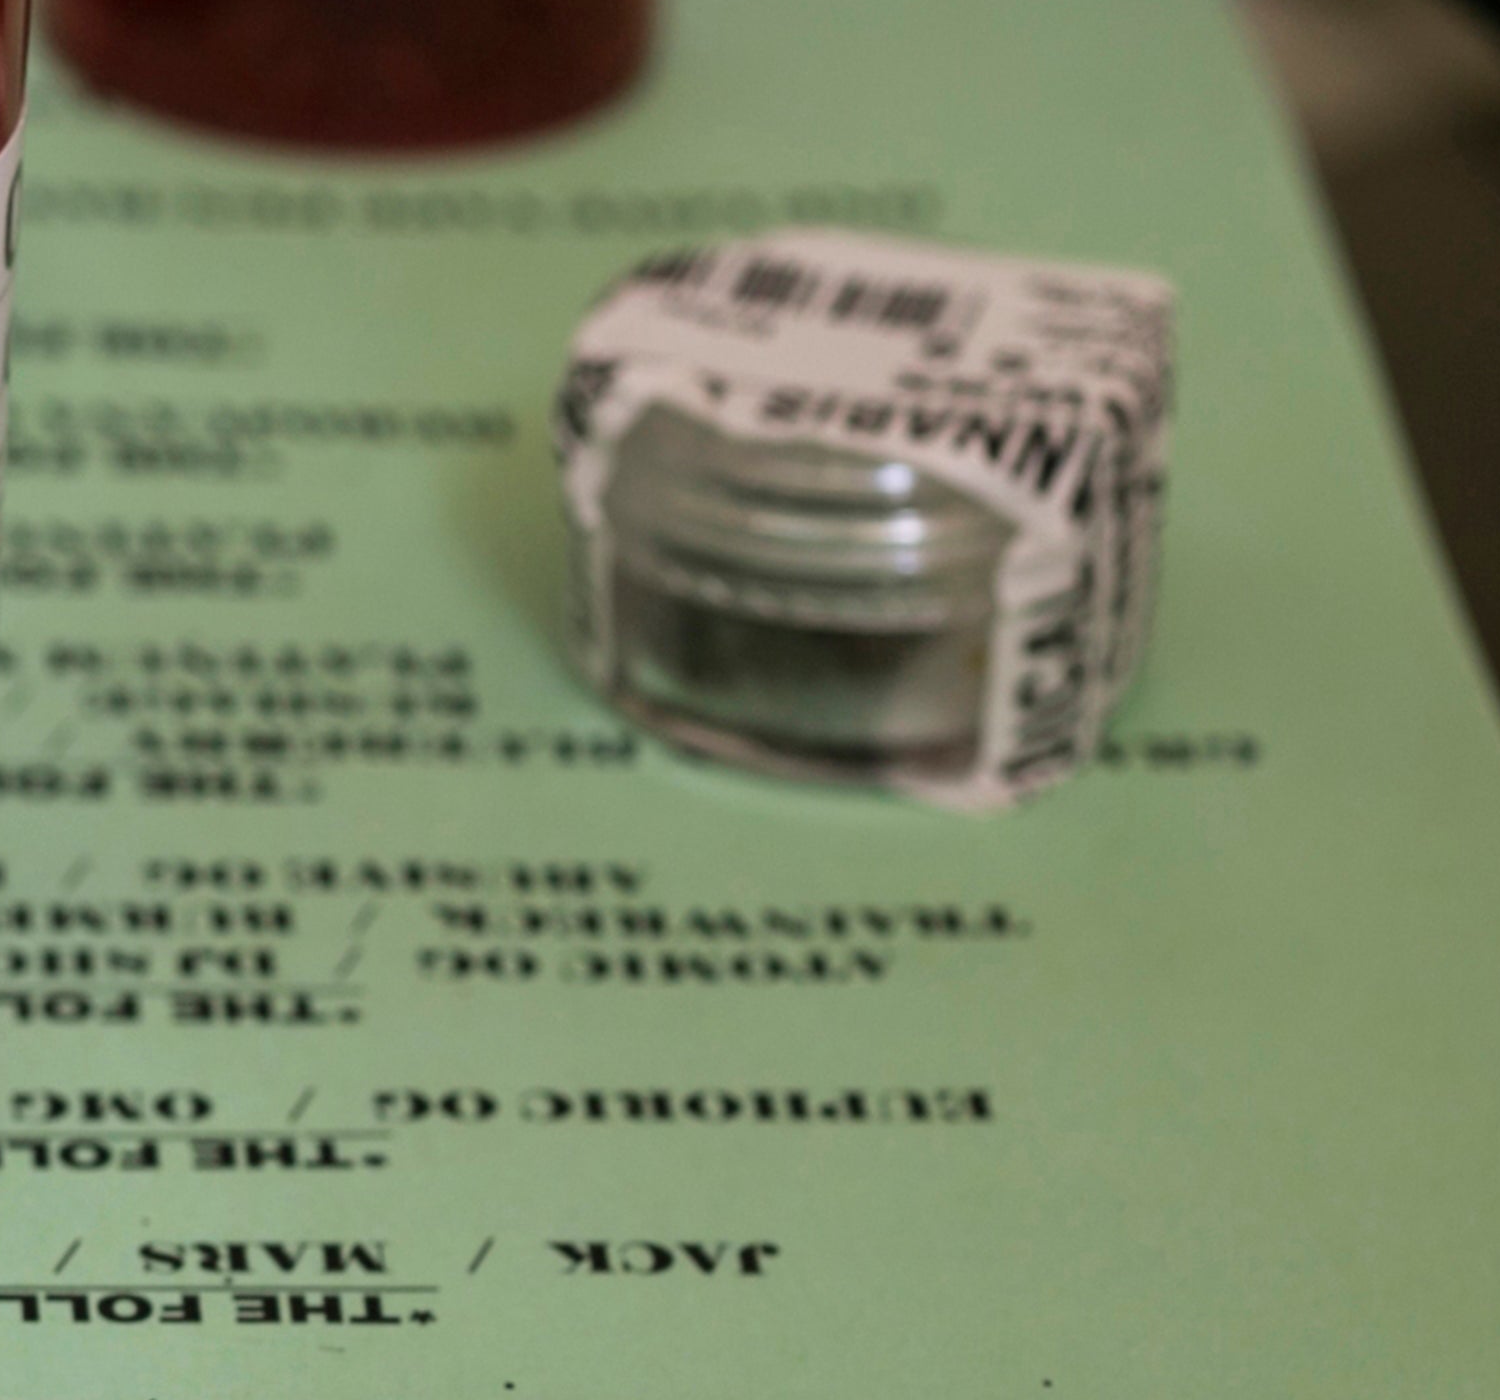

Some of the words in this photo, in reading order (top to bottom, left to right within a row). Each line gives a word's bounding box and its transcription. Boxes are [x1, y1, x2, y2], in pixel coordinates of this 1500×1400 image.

[414, 945, 540, 983] OG
[560, 947, 896, 984] ATOMIC
[8, 1088, 214, 1123] OMG
[369, 1086, 500, 1124] OG
[512, 1086, 994, 1125] EUPHORIC
[136, 1240, 388, 1277] MARS
[543, 1239, 783, 1277] JACK
